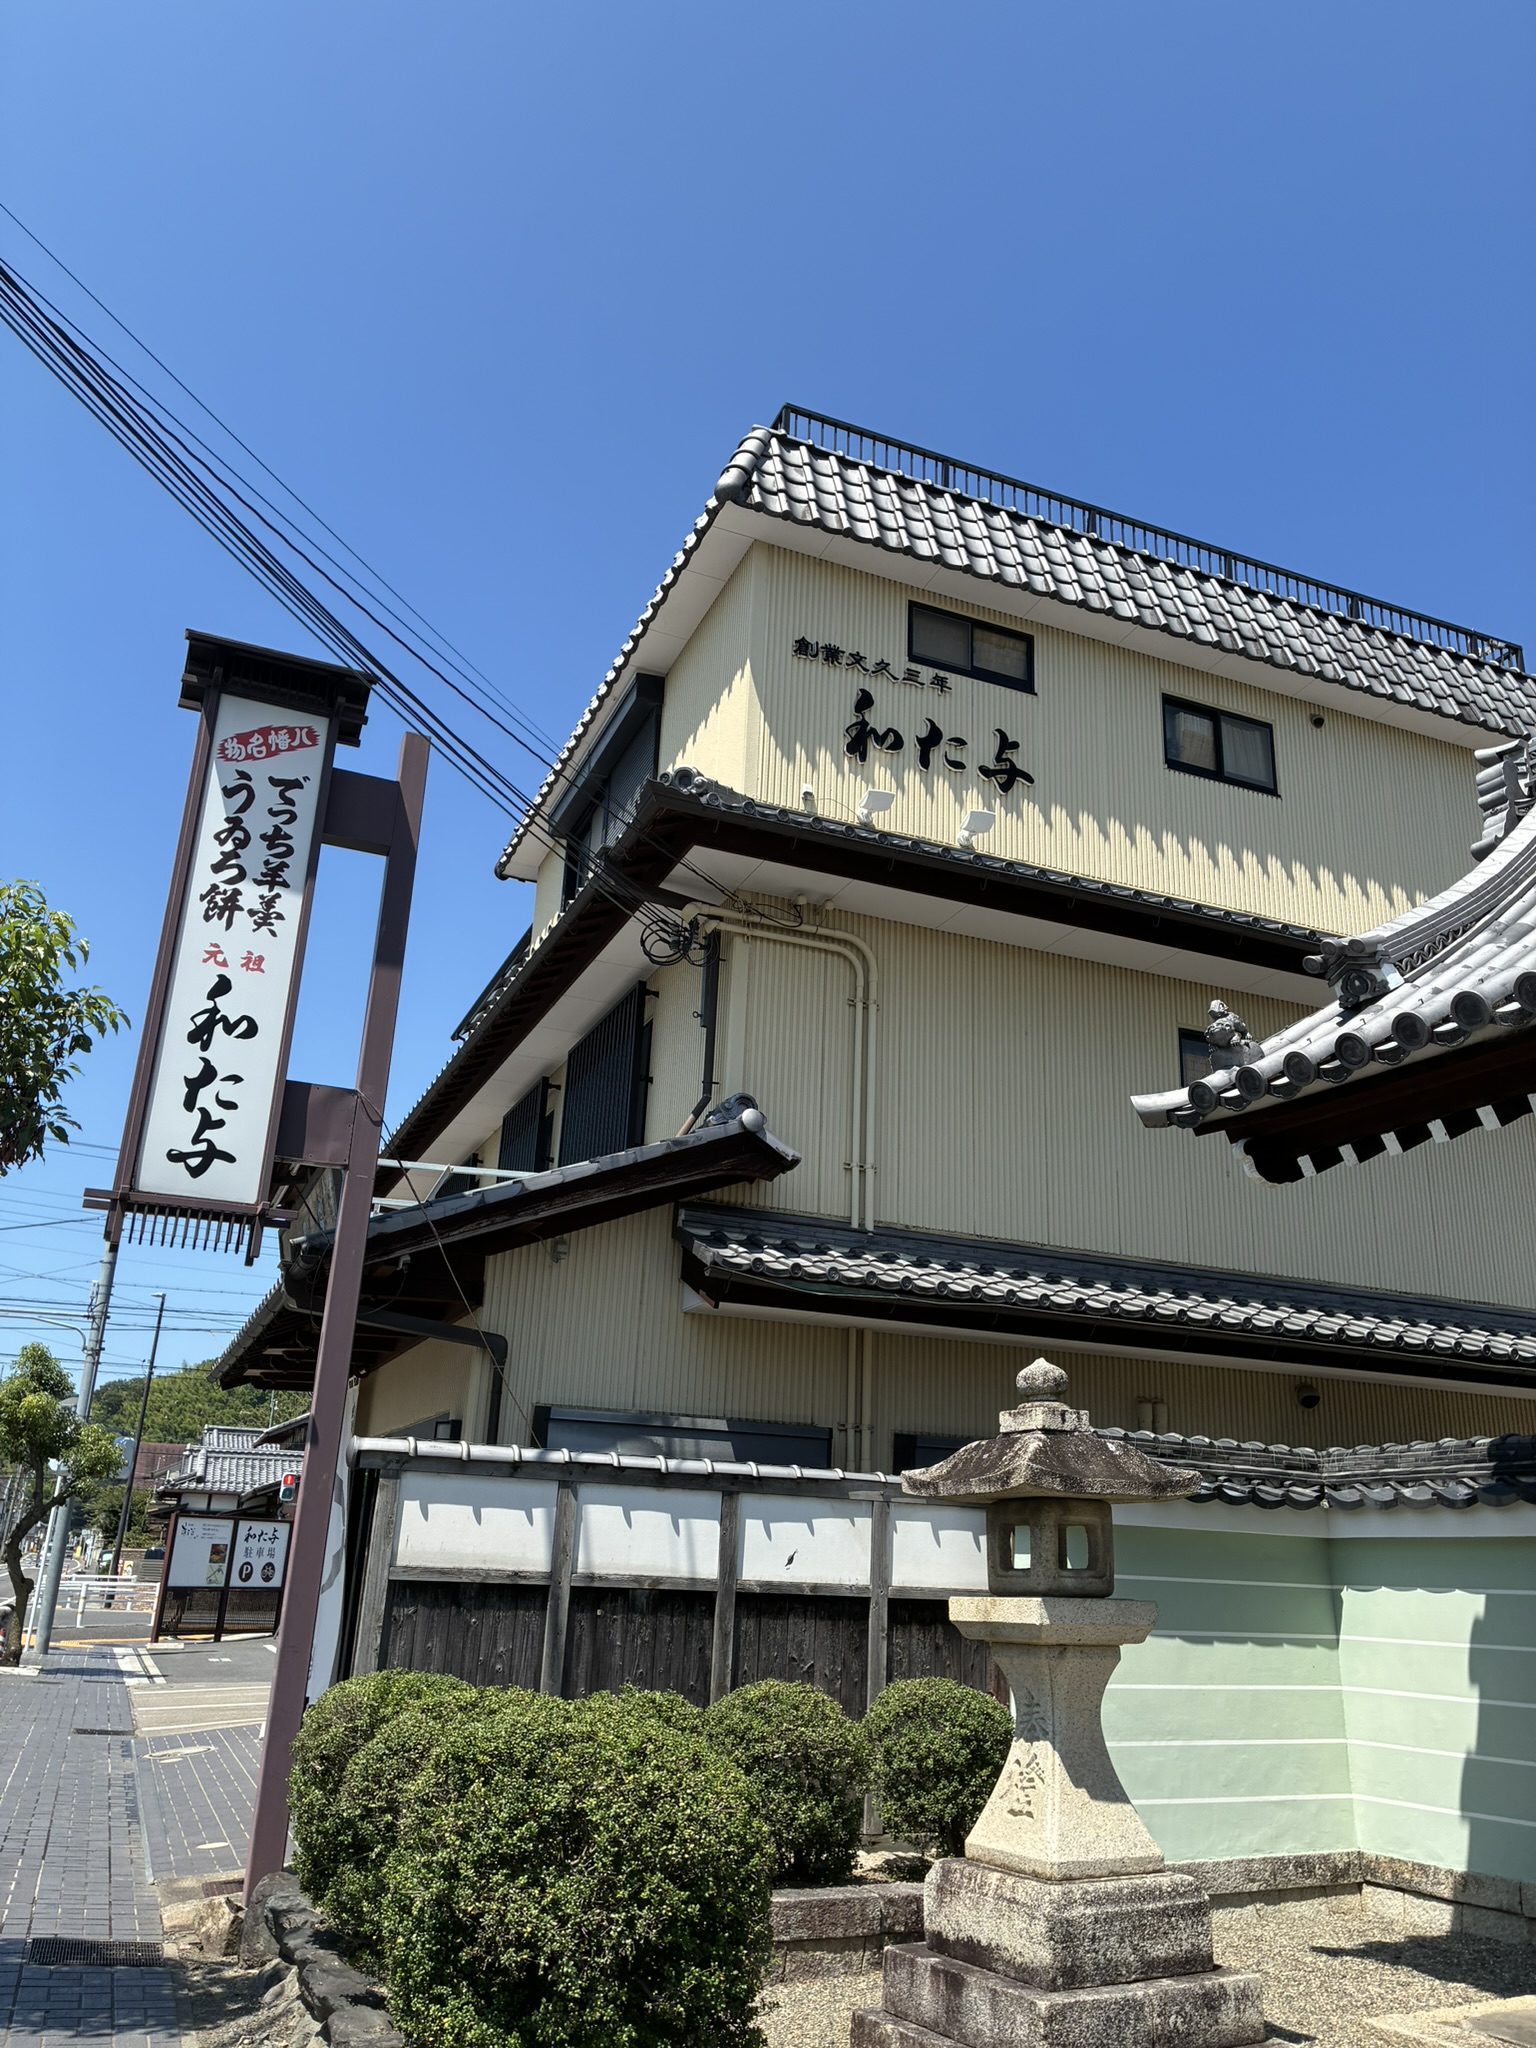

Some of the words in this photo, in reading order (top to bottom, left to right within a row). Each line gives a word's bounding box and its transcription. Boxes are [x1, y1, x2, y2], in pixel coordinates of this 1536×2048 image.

[792, 636, 952, 695] 創業文久三年
[224, 727, 312, 761] 八幡名物
[844, 688, 1035, 795] 和た与
[246, 775, 311, 938] でっち羊羹
[202, 942, 266, 975] 元祖
[166, 973, 260, 1179] 和た与
[243, 1547, 276, 1559] 駐車場
[244, 1526, 279, 1545] 和た与
